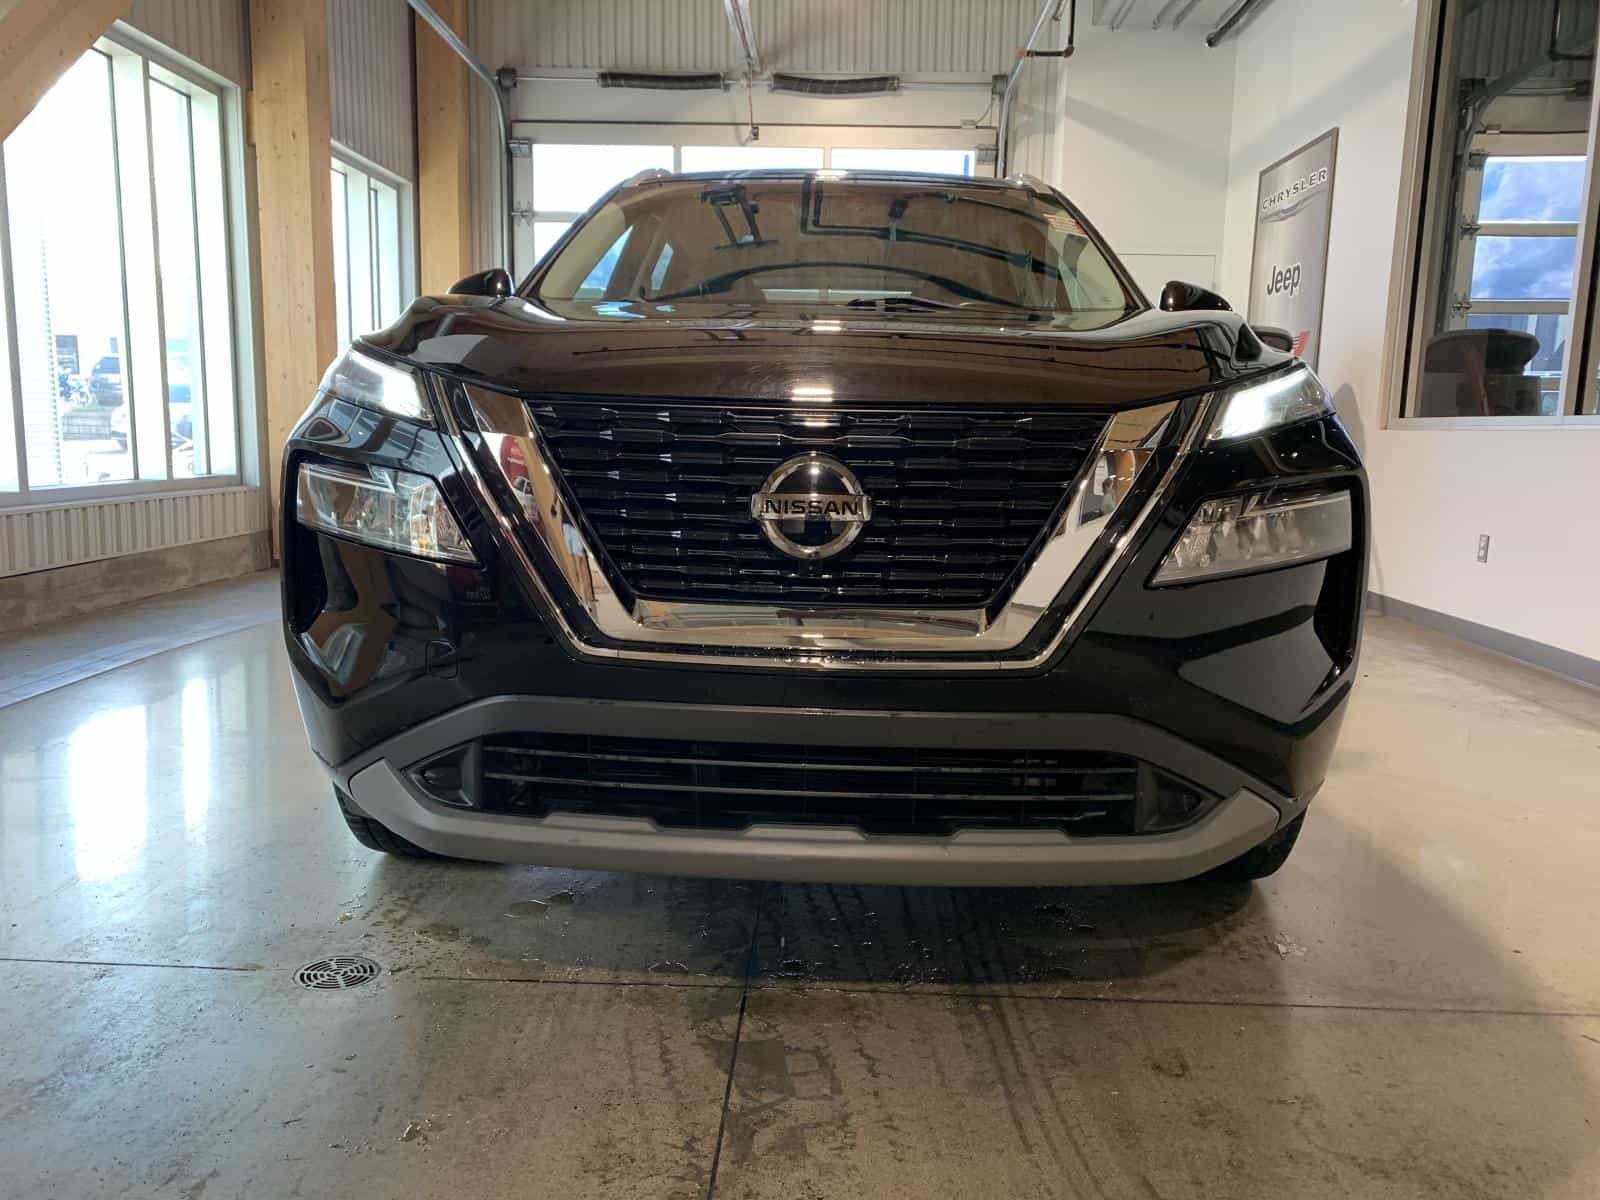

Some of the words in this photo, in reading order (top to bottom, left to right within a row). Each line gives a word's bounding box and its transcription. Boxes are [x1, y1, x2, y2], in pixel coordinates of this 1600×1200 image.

[1262, 168, 1328, 210] CHRYSLER
[1267, 263, 1301, 296] Jeep
[765, 499, 859, 515] NISSAN
